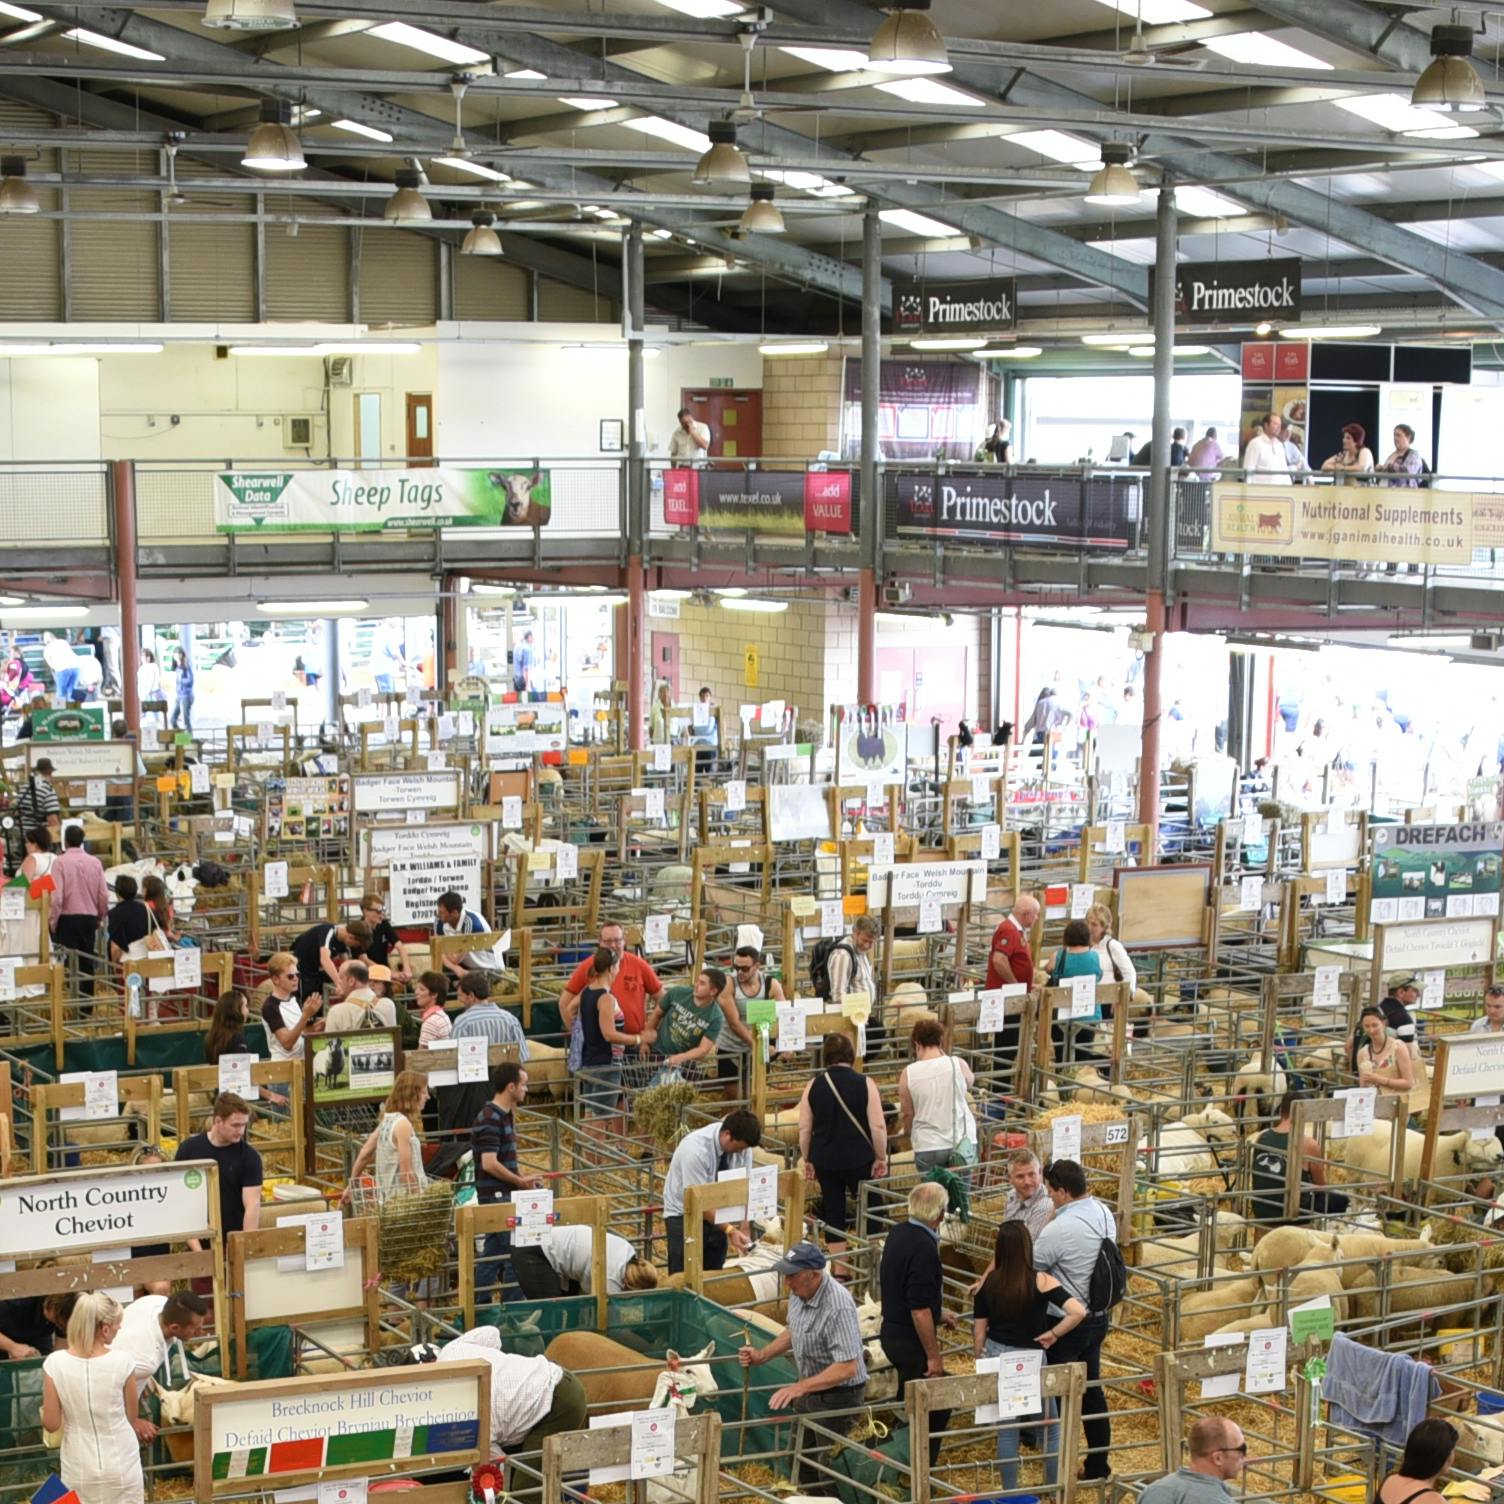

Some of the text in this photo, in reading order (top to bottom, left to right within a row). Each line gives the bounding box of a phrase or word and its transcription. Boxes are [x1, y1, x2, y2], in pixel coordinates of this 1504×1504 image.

[1191, 277, 1295, 311] Primestock
[928, 293, 1011, 323] Primestock
[231, 474, 284, 489] Shearwell
[244, 490, 272, 503] Data
[330, 479, 444, 510] Sheep Tags
[719, 492, 782, 505] www.texel.co.uk
[812, 504, 843, 518] VALUE
[941, 485, 1058, 526] Primestock
[1301, 501, 1371, 521] Nutritional
[1375, 503, 1463, 526] Supplements
[1300, 528, 1464, 550] www.jganimalhealth.co.uk
[355, 776, 424, 788] Badger Face Welsh
[1396, 825, 1486, 845] DREFACH
[410, 861, 445, 871] WILLIAMS
[453, 858, 477, 868] FAMILY
[924, 869, 947, 878] Welsh
[403, 887, 429, 896] Badger
[429, 884, 447, 894] Face
[1476, 1044, 1499, 1057] North
[1106, 1125, 1128, 1143] 572
[18, 1185, 168, 1215] North Country
[55, 1212, 134, 1236] Cheviot
[272, 1387, 433, 1418] Brecknock Hill Cheviot
[224, 1429, 273, 1449] Defaid
[276, 1423, 332, 1442] Cheviot
